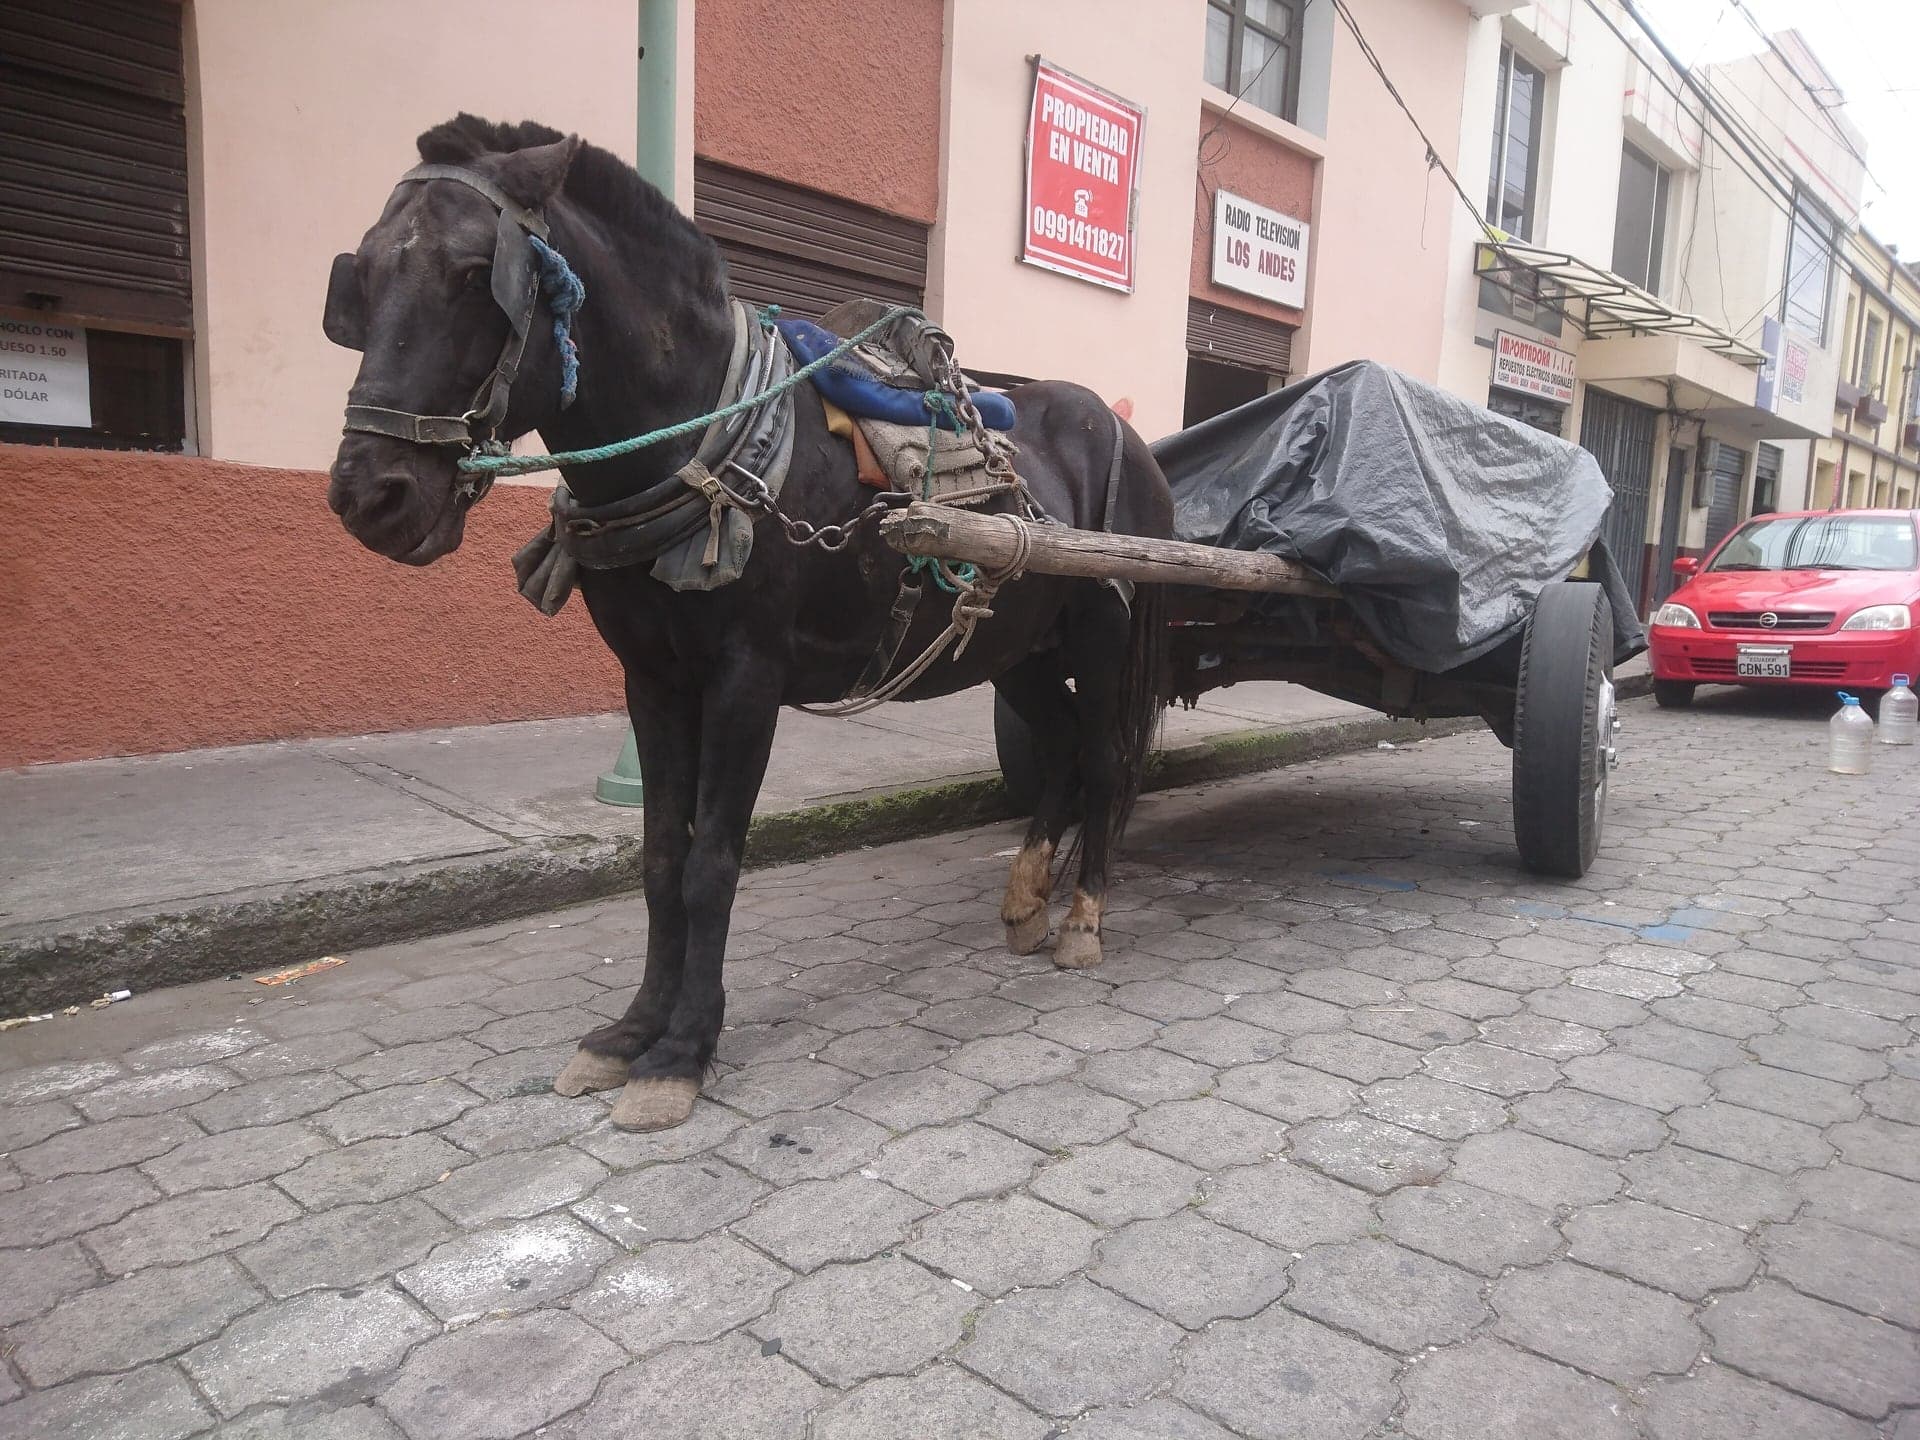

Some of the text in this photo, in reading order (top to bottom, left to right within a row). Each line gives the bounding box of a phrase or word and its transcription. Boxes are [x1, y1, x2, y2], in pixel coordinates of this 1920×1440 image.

[1042, 93, 1128, 156] PROPIEDAD
[1050, 130, 1118, 186] EN VENTA
[1033, 206, 1125, 263] 0991411827
[1225, 203, 1301, 251] RADIO TELEVISION
[1226, 236, 1296, 283] LOS ANDES
[46, 328, 74, 340] CON
[40, 345, 66, 357] 1.50
[1500, 335, 1550, 367] IMPORTADORA
[1499, 357, 1524, 376] REPUESTOS
[1526, 363, 1550, 382] ELECTRICOS
[1551, 373, 1573, 389] ORIGINALES
[4, 387, 48, 402] DÓLAR
[1739, 663, 1788, 676] CBN-591
